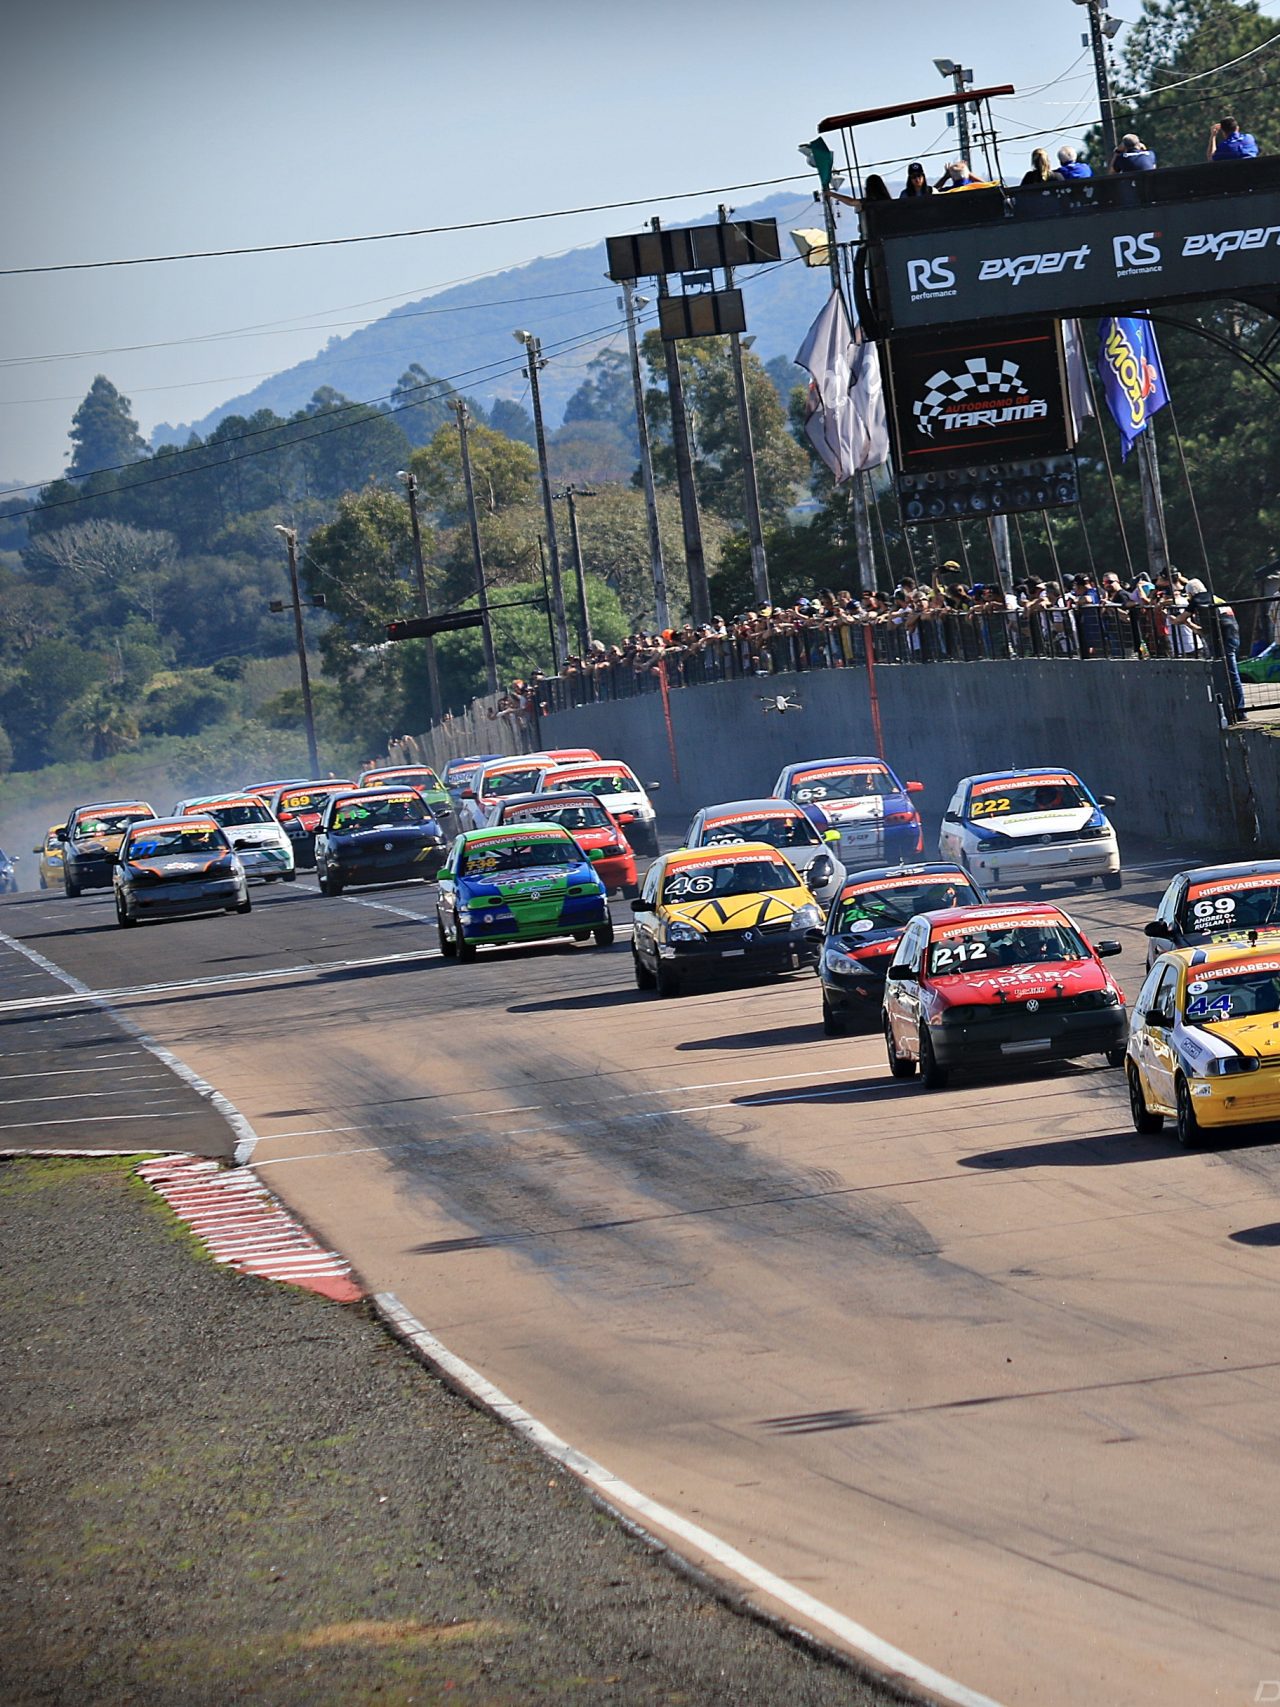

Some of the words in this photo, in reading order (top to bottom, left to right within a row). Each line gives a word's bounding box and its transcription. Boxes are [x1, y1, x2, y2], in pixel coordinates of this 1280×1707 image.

[1112, 232, 1161, 268] RS
[906, 256, 956, 292] RS
[978, 244, 1091, 286] expert
[1116, 265, 1162, 278] performance
[911, 289, 957, 302] performance
[938, 399, 1048, 430] TARUMÃ
[280, 795, 310, 809] 169
[797, 787, 827, 800] 63
[972, 798, 1011, 816] 222
[672, 855, 773, 874] HIPERVAREJO.COM.BR
[665, 875, 714, 895] 46
[1193, 897, 1236, 917] 69
[942, 919, 1065, 939] HIPERVAREJO.COM.BR
[1194, 914, 1223, 925] ANDREI
[1194, 920, 1225, 931] RUSLAN
[936, 943, 987, 967] 212
[967, 970, 1082, 988] VIDEIRA
[1186, 994, 1234, 1015] 44
